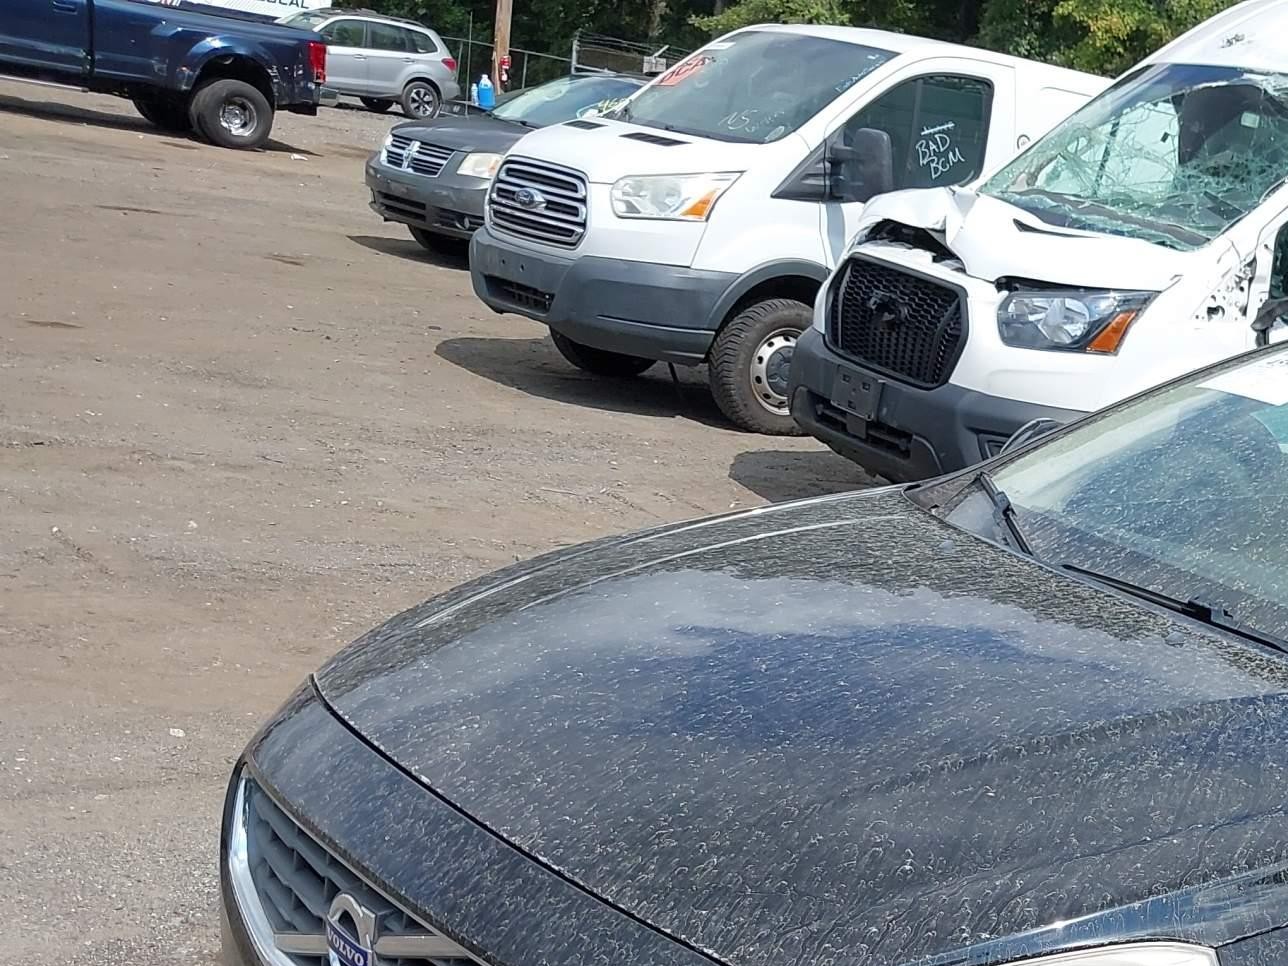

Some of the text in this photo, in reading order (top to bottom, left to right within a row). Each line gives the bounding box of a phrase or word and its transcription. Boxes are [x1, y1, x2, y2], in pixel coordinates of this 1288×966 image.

[257, 0, 309, 9] CAL
[916, 133, 951, 167] BAD
[929, 147, 965, 180] BCM
[327, 927, 365, 966] VOLVO
